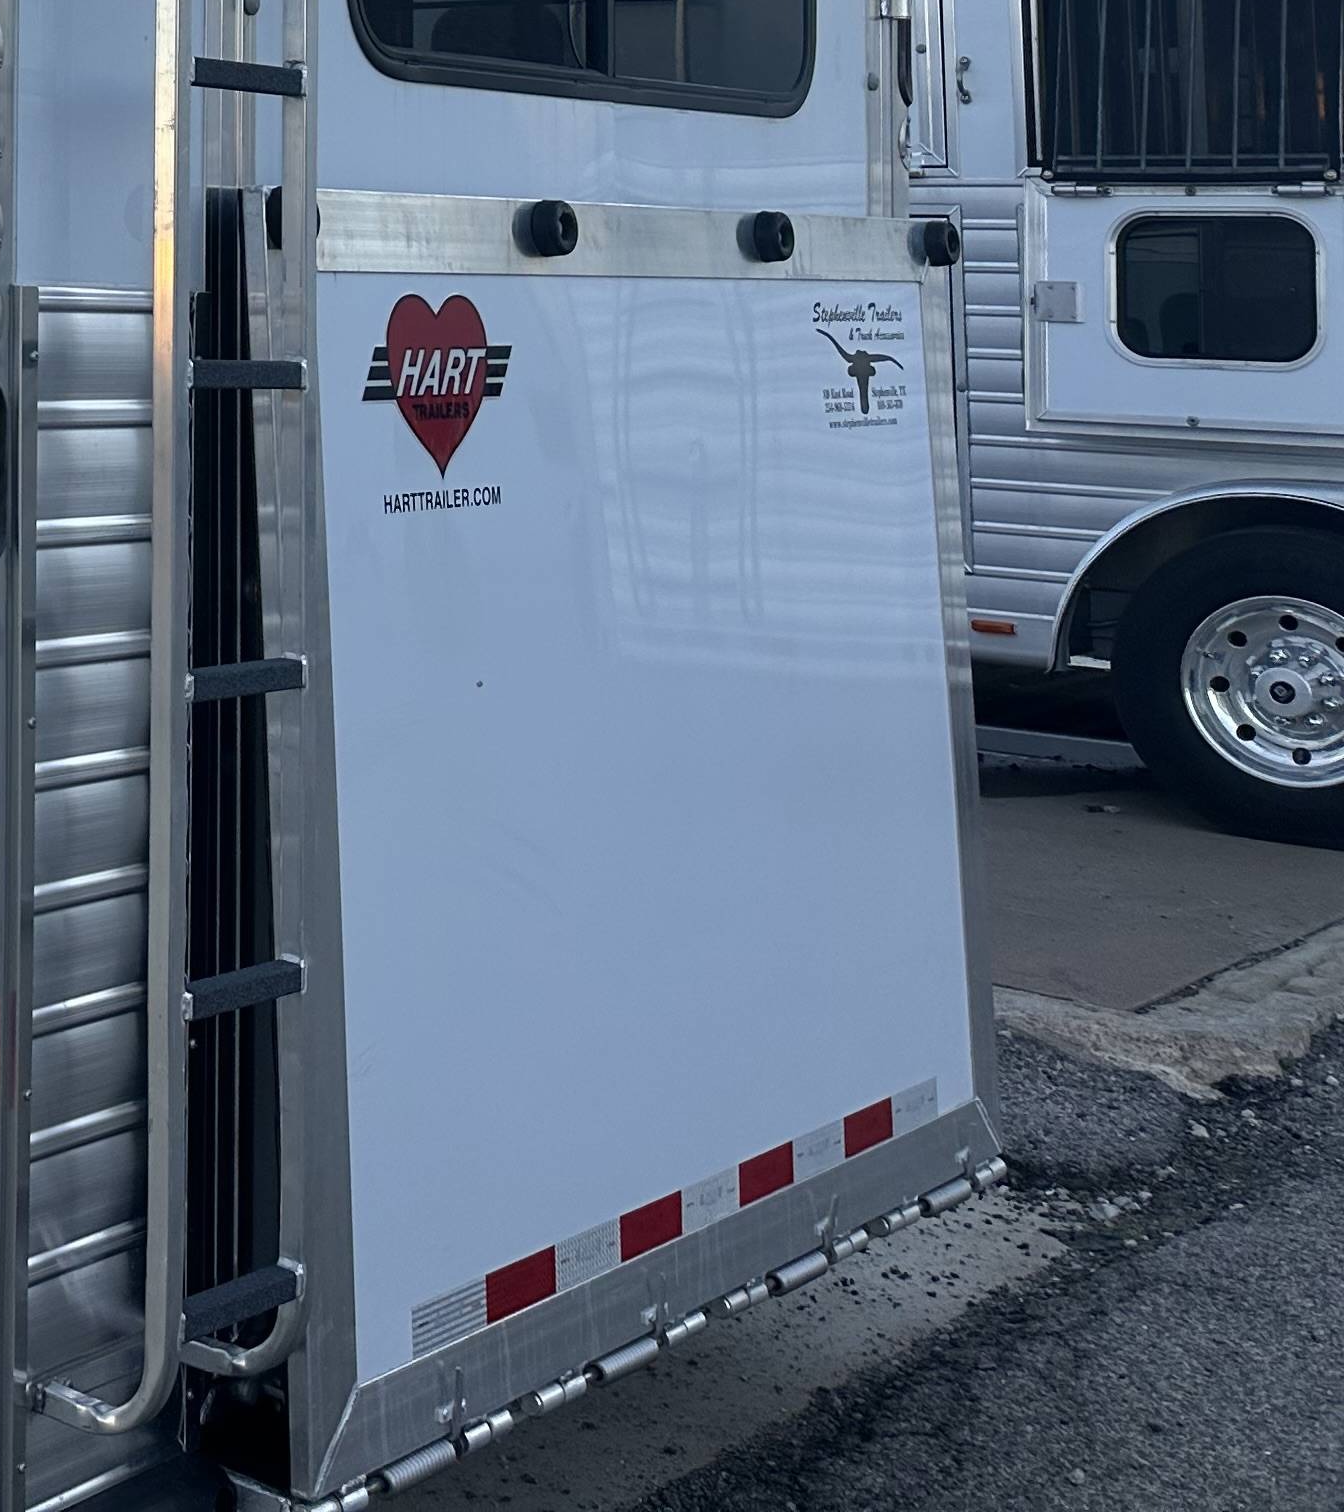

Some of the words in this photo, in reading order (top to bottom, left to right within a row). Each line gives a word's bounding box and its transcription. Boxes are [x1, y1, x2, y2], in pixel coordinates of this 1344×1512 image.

[813, 302, 865, 328] Stephenville
[868, 302, 903, 322] Trailers
[396, 348, 487, 397] HART
[413, 403, 470, 420] TRAILERS
[383, 486, 502, 514] HARTTRAILER.COM
